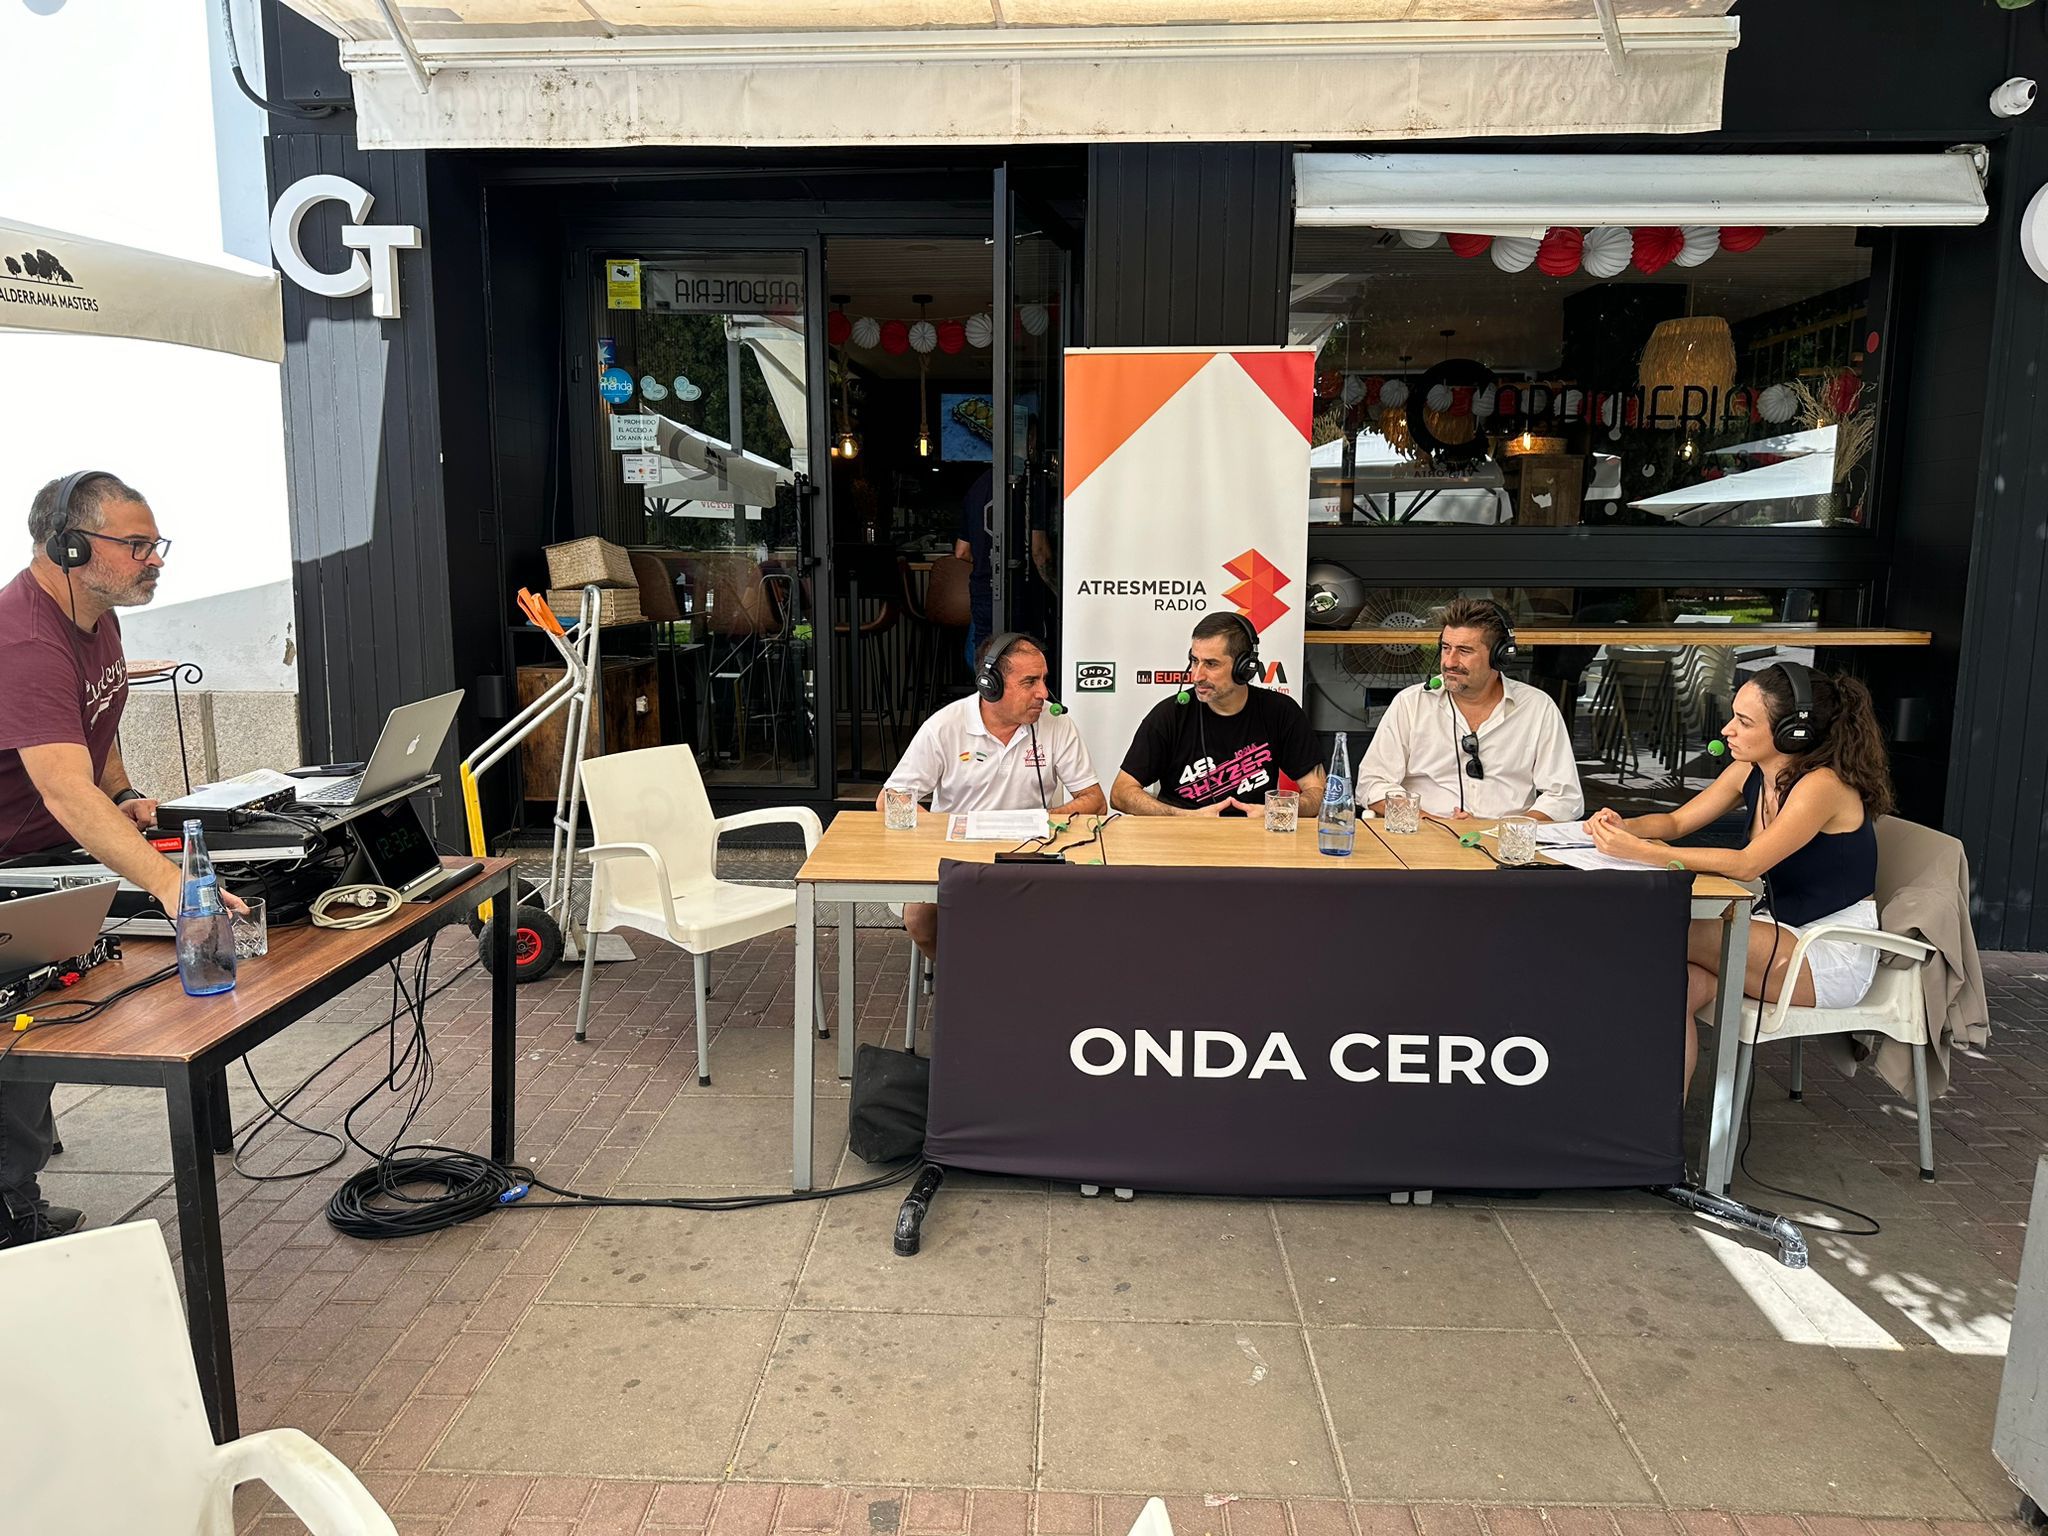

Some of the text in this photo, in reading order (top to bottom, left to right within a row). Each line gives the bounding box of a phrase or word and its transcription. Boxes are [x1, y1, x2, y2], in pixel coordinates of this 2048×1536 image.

[0, 287, 99, 312] ALDERRAMA MASTERS
[701, 501, 734, 509] VICTOR
[1077, 580, 1207, 595] ATRESMEDIA
[1154, 599, 1207, 611] RADIO
[1156, 673, 1192, 683] EURO
[1236, 768, 1270, 795] 43
[1069, 1027, 1550, 1087] ONDA CERO
